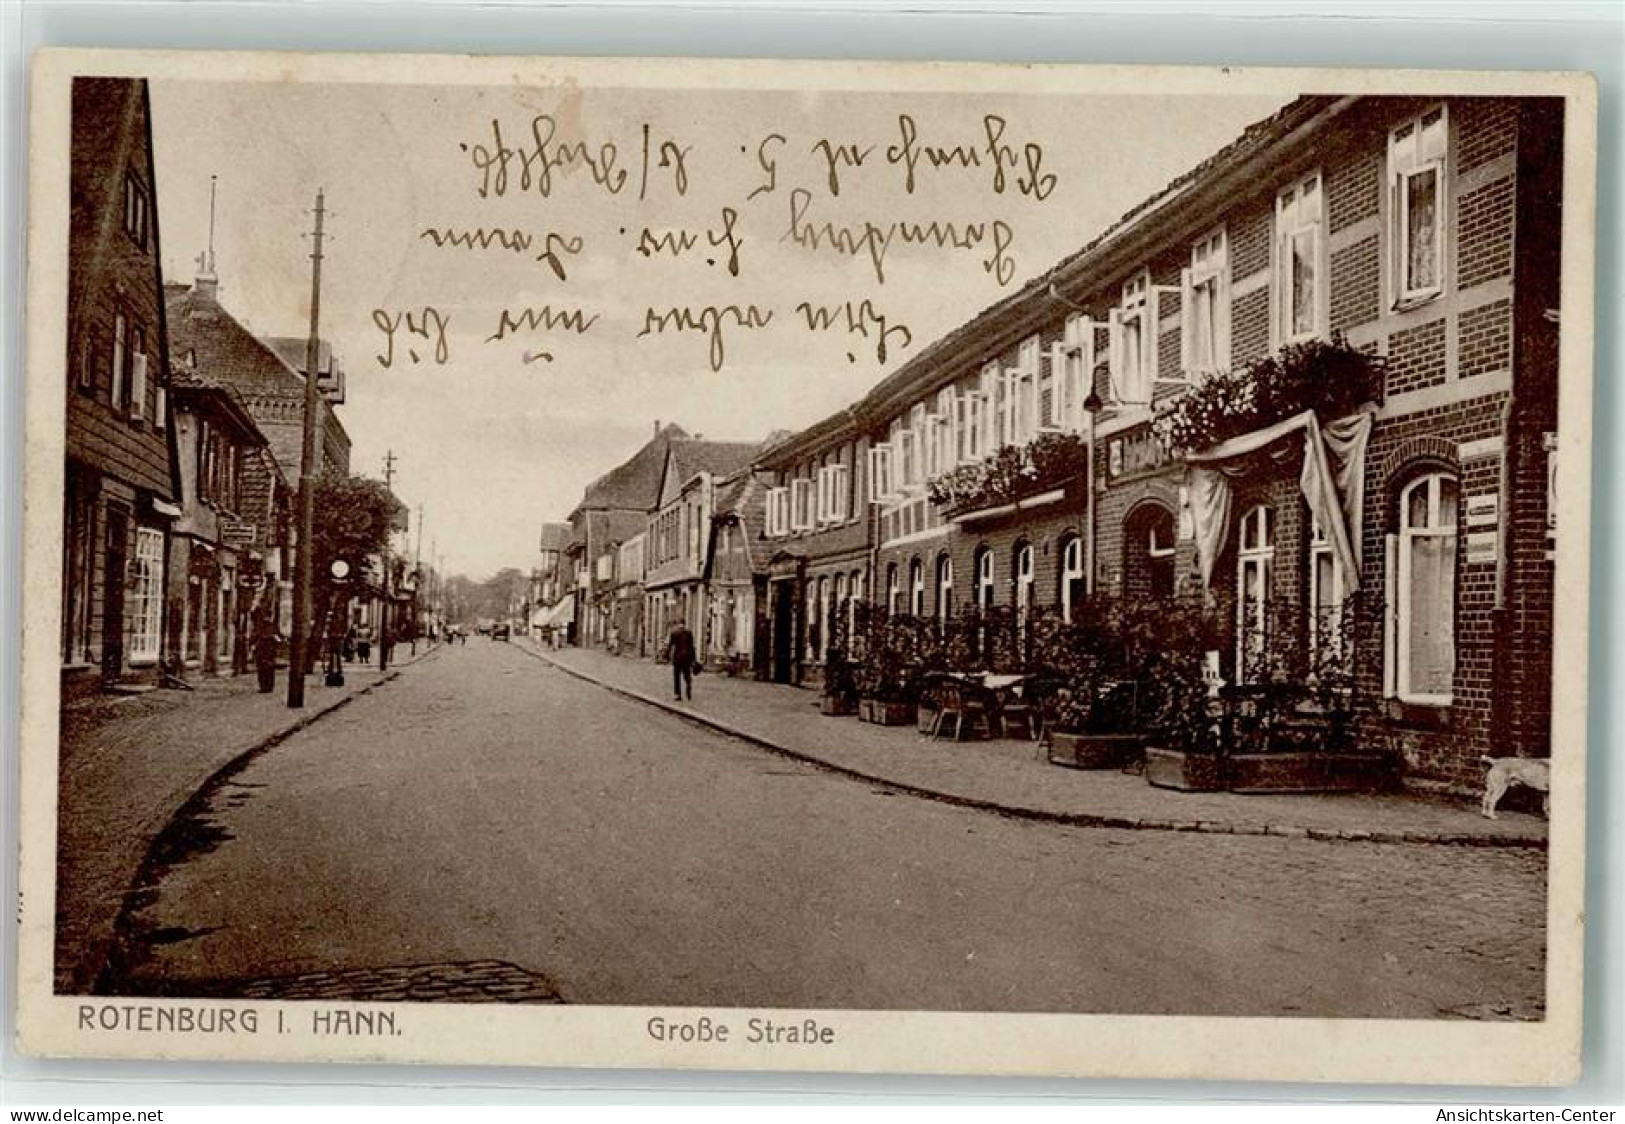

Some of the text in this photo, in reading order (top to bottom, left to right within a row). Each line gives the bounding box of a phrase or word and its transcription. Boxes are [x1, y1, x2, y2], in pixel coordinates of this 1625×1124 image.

[419, 227, 585, 283] Dann
[787, 189, 1017, 288] Sonntag
[371, 306, 451, 369] bis
[484, 305, 600, 365] nur
[635, 304, 774, 373] aber
[78, 1005, 258, 1034] ROTENBURG
[312, 1010, 402, 1037] HANN.
[647, 1016, 836, 1045] Große Straße
